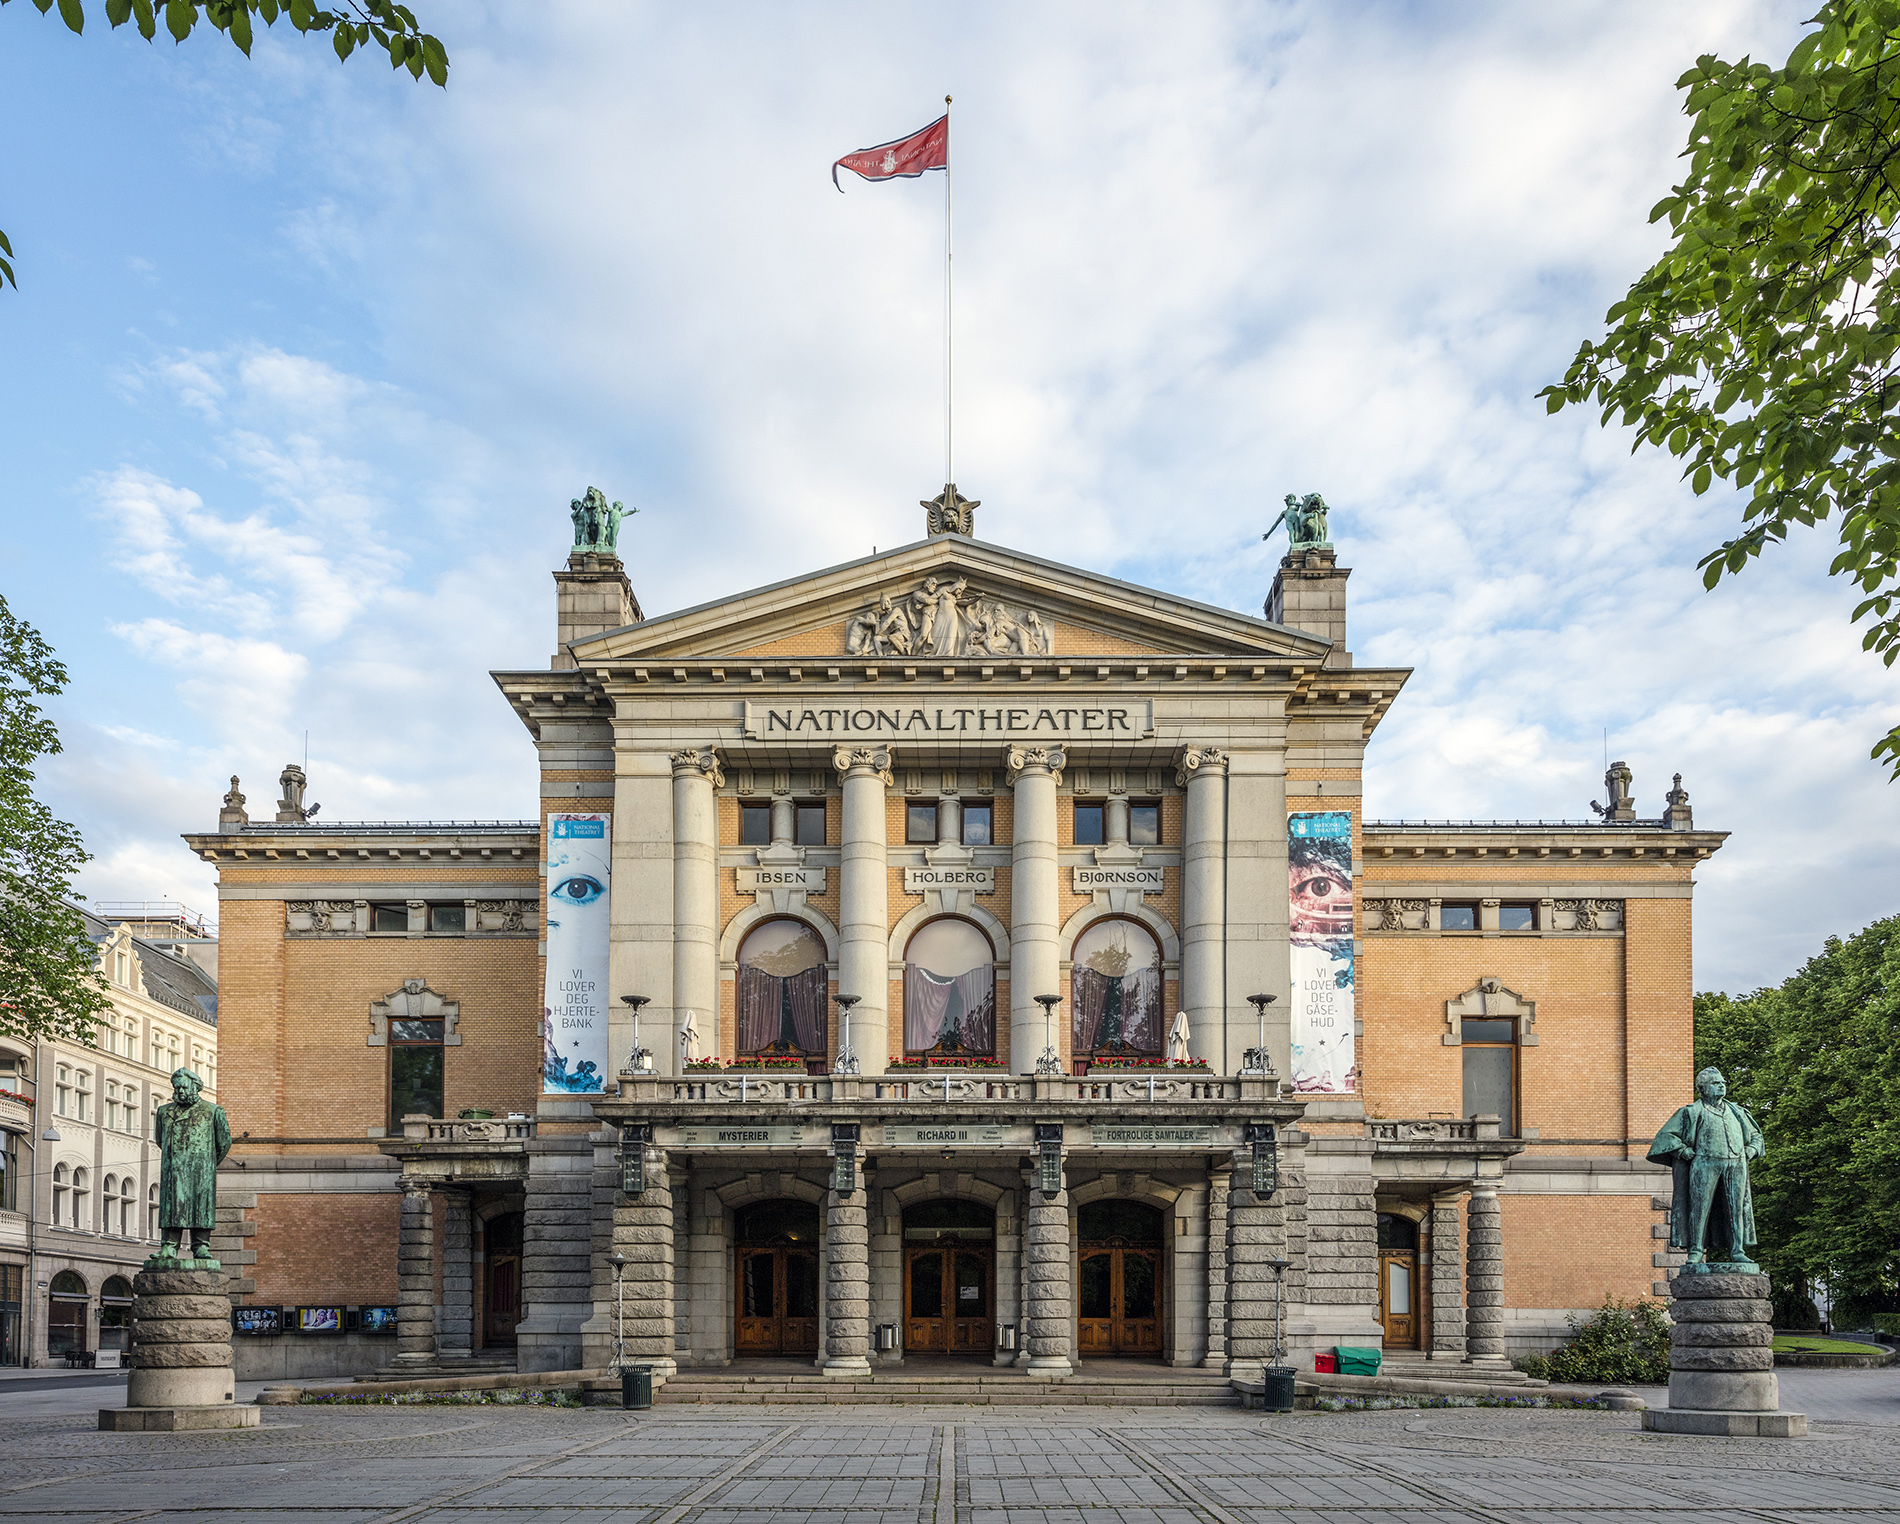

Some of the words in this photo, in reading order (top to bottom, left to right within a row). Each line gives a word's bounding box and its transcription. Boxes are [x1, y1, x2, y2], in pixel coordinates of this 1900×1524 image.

[768, 708, 1131, 731] NATIONALTHEATER
[756, 872, 806, 883] IBSEN
[913, 872, 986, 883] HOLBERG
[1079, 872, 1158, 885] BJØRNSON
[572, 969, 583, 979] VI
[1316, 968, 1327, 978] VI
[559, 981, 596, 992] LOVER
[566, 993, 589, 1004] DEG
[1311, 992, 1334, 1003] DEG
[554, 1005, 600, 1017] HJERTE-
[1306, 1003, 1338, 1015] GÅSE-
[561, 1018, 593, 1029] BANK
[1310, 1017, 1335, 1028] HUD
[718, 1131, 769, 1141] MYSTERIER
[917, 1130, 957, 1140] RICHARD
[958, 1130, 968, 1140] III
[1107, 1130, 1153, 1140] FORTROLIGE
[1154, 1130, 1194, 1140] SAMTALER
